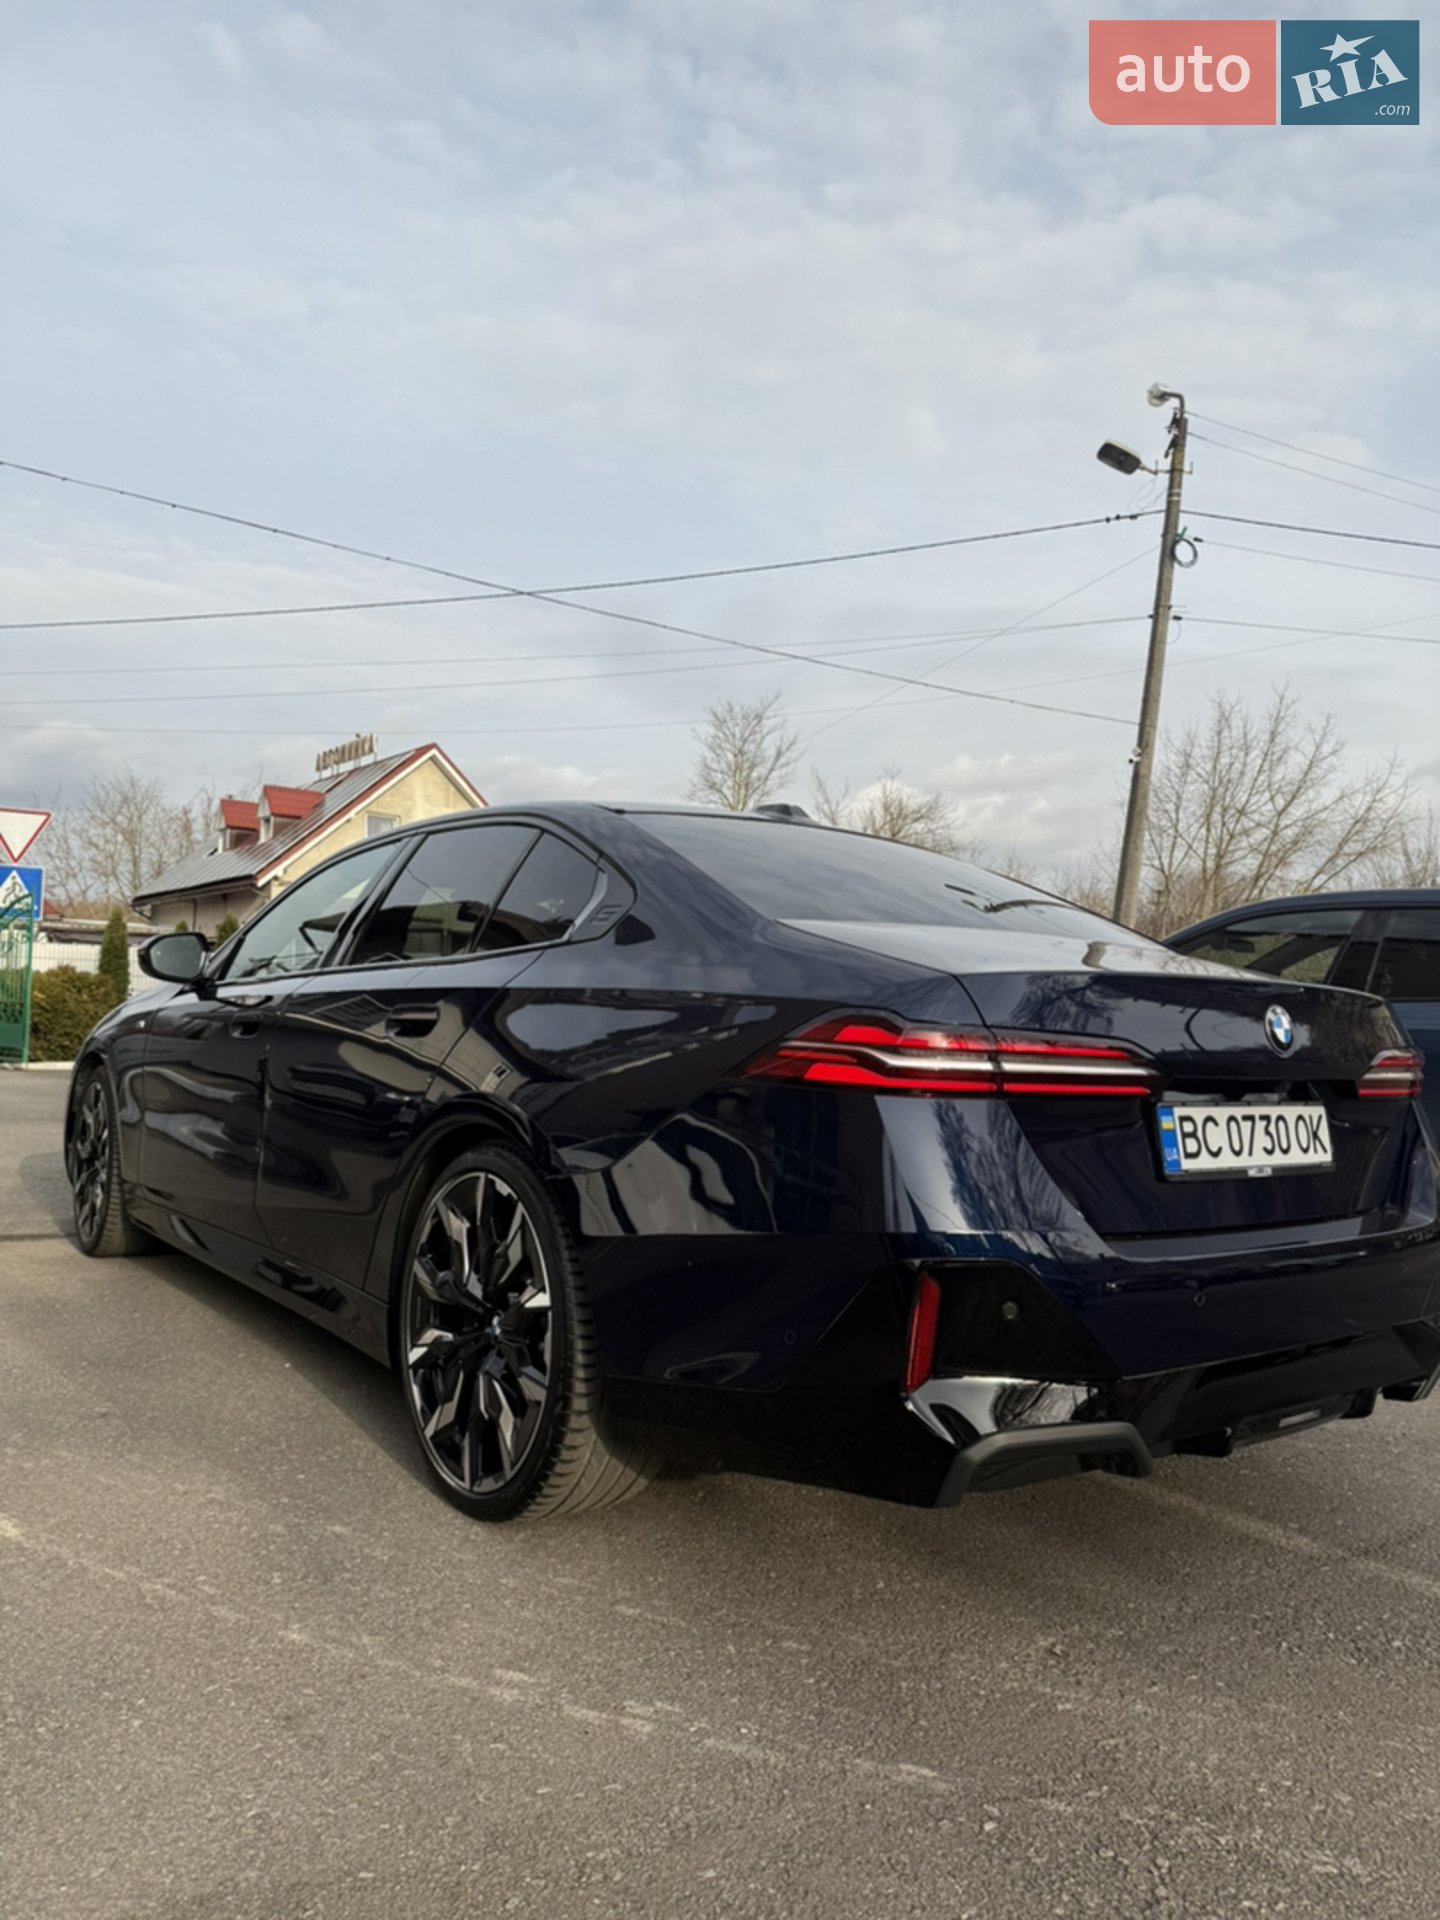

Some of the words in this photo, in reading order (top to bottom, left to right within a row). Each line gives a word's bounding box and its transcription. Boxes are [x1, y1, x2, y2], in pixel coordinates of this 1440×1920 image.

[1177, 1114, 1223, 1160] BC
[1226, 1113, 1292, 1158] 0730
[1294, 1113, 1329, 1155] OK
